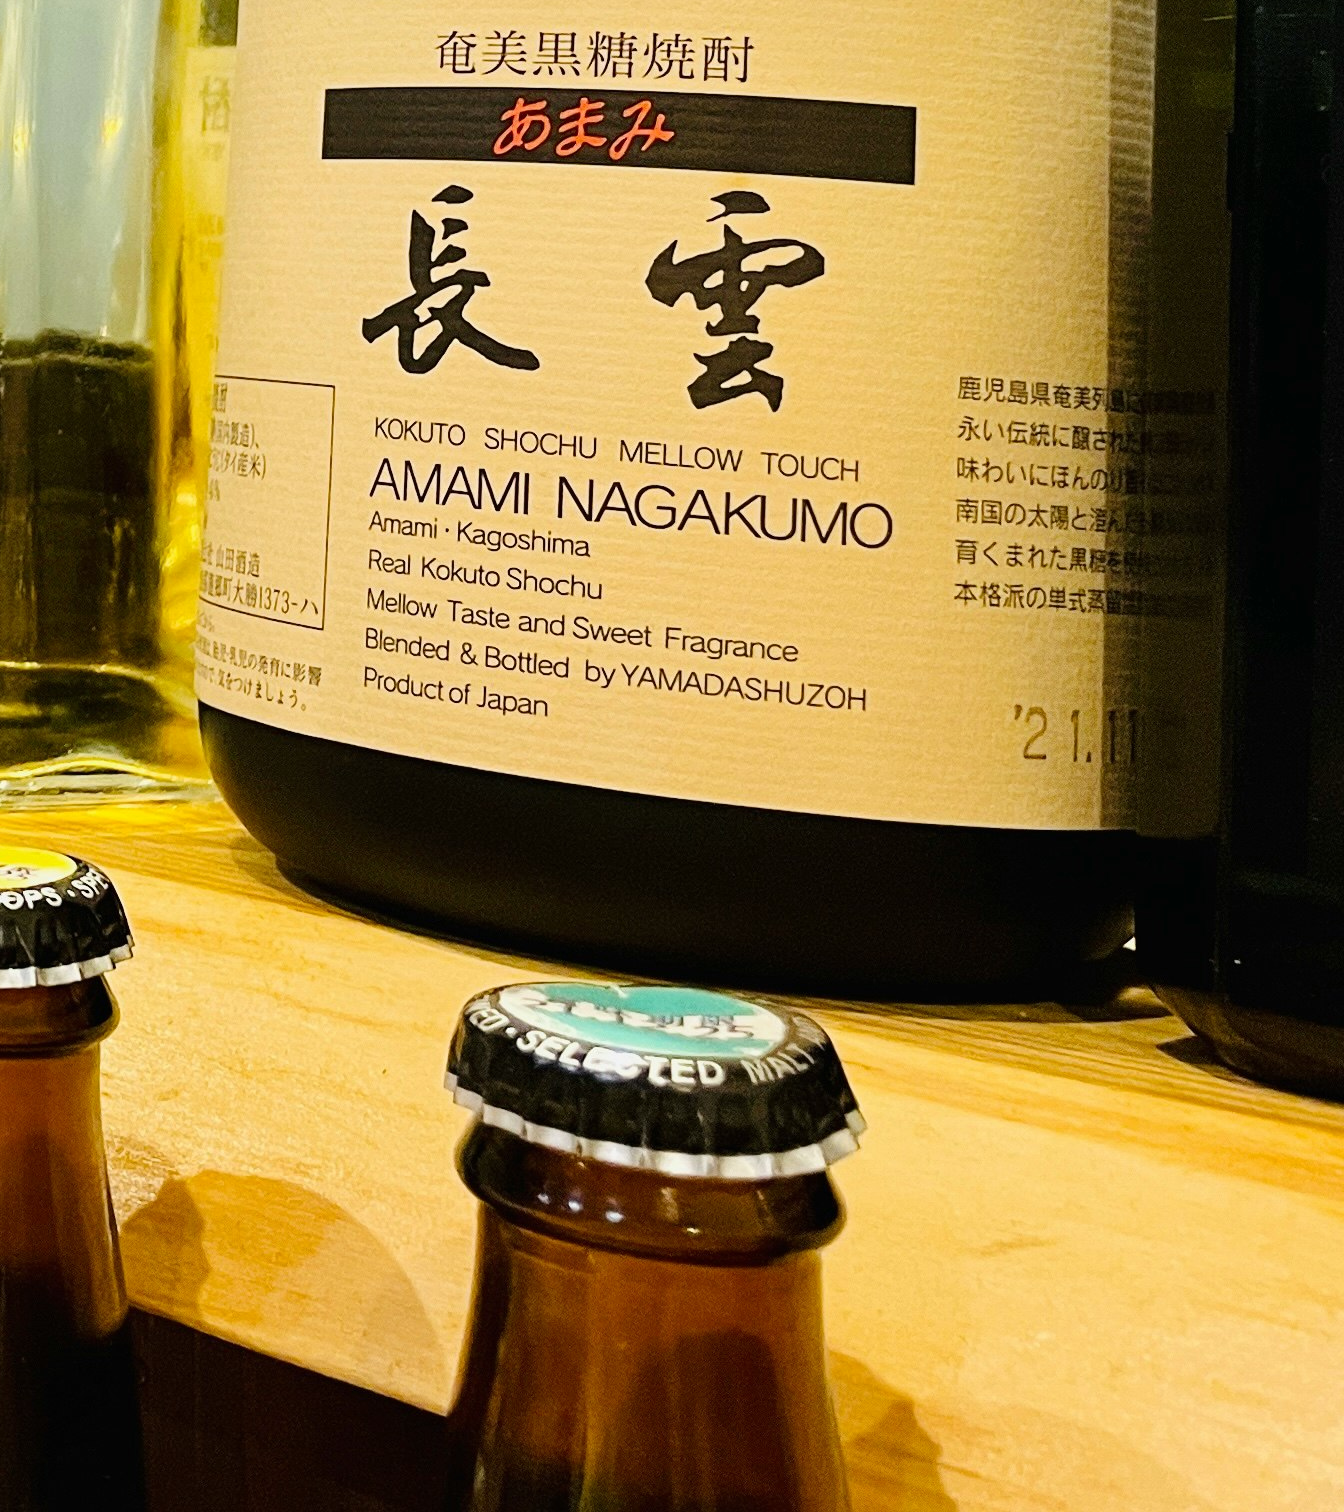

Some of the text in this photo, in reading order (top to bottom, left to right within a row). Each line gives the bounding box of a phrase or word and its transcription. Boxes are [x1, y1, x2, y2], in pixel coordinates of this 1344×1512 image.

[433, 30, 756, 84] 奄美黒糖焼酎
[492, 97, 676, 160] あまみ
[375, 417, 860, 483] KOKUTO SHOCHU MELLOW TOUCH
[368, 457, 894, 549] AMAMI NAGAKUMO
[368, 510, 592, 558] Amami Kagoshima
[368, 549, 604, 601] Real Kokuto Shochu
[366, 587, 800, 662] Mellow Taste and Sweet Fragrance
[363, 666, 550, 717] Product of Japan
[364, 627, 868, 712] Blended & Bottled by YAMADASHUZOH
[515, 1029, 727, 1088] SELECTED
